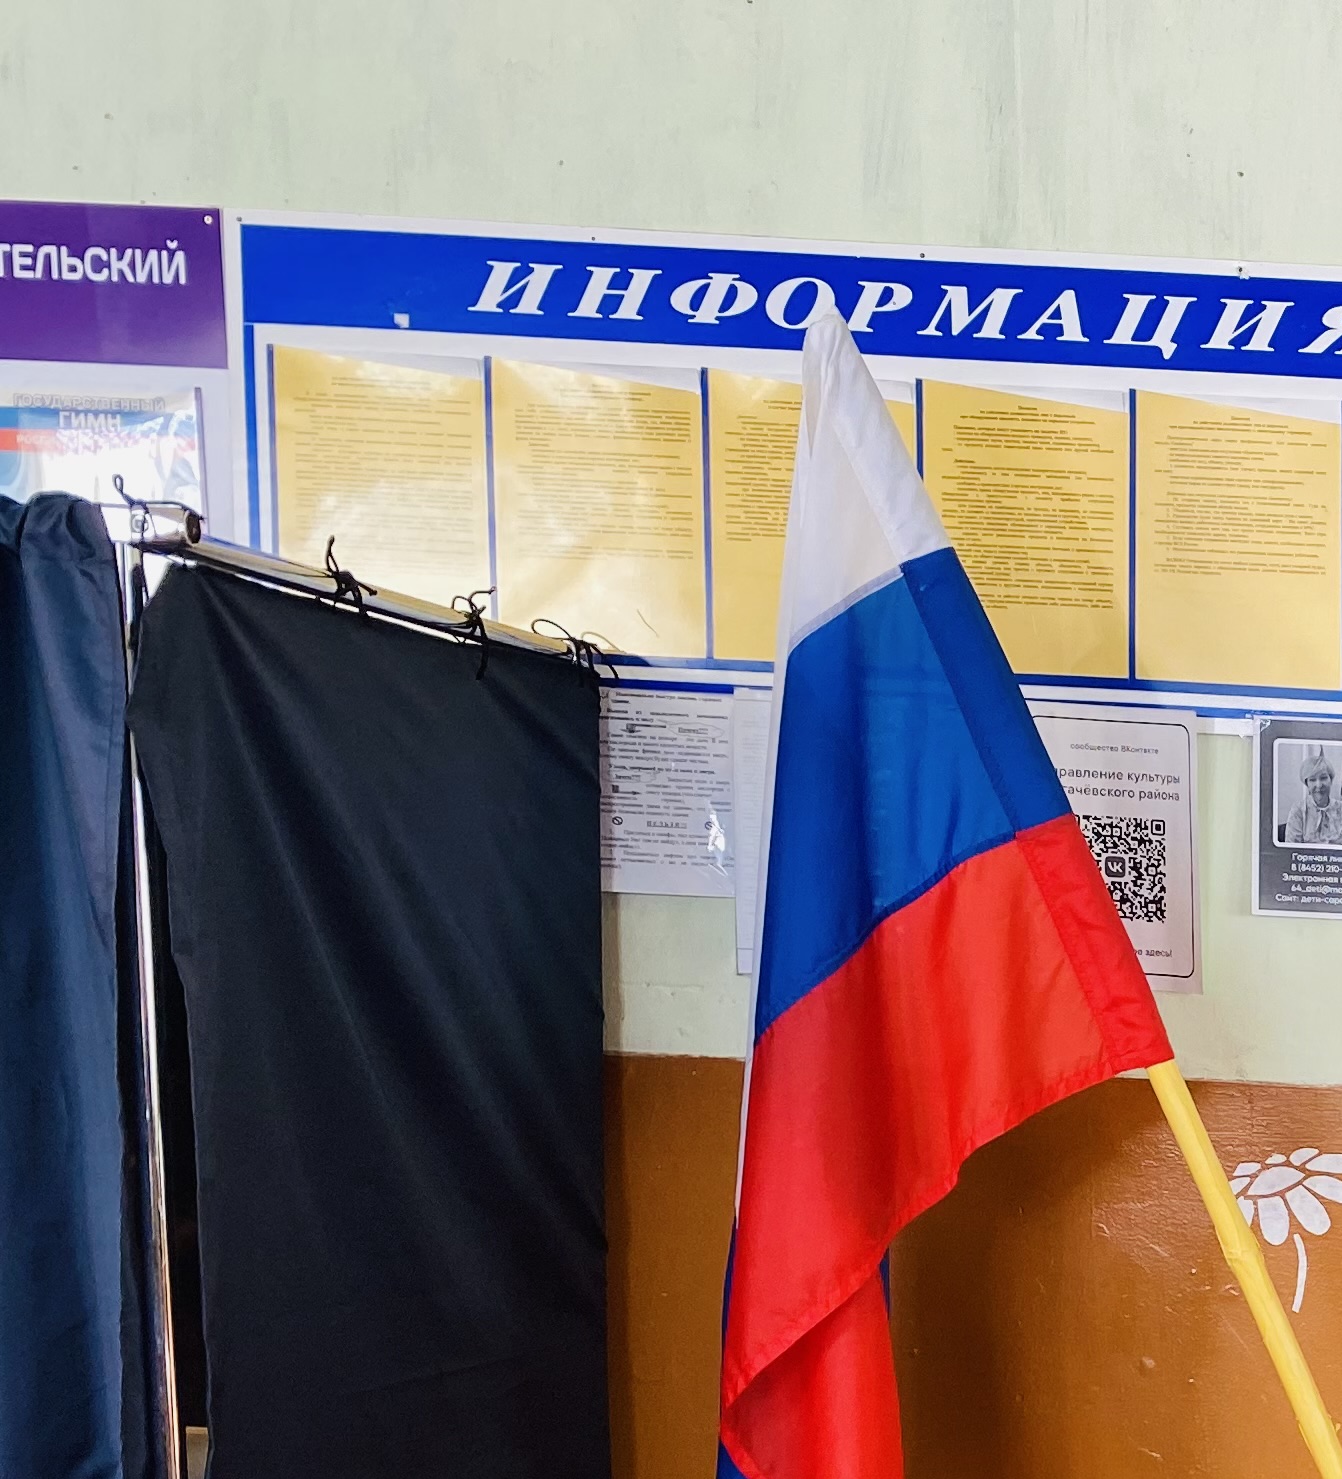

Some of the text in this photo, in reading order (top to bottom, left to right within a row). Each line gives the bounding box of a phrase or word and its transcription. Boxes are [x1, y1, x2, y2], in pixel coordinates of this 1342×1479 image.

[58, 411, 121, 432] ГИМН
[1055, 767, 1180, 786] равление культуры
[1138, 787, 1180, 802] района
[1291, 852, 1328, 863] Горячая
[1298, 864, 1325, 873] (8452)
[1282, 873, 1339, 884] Электронная
